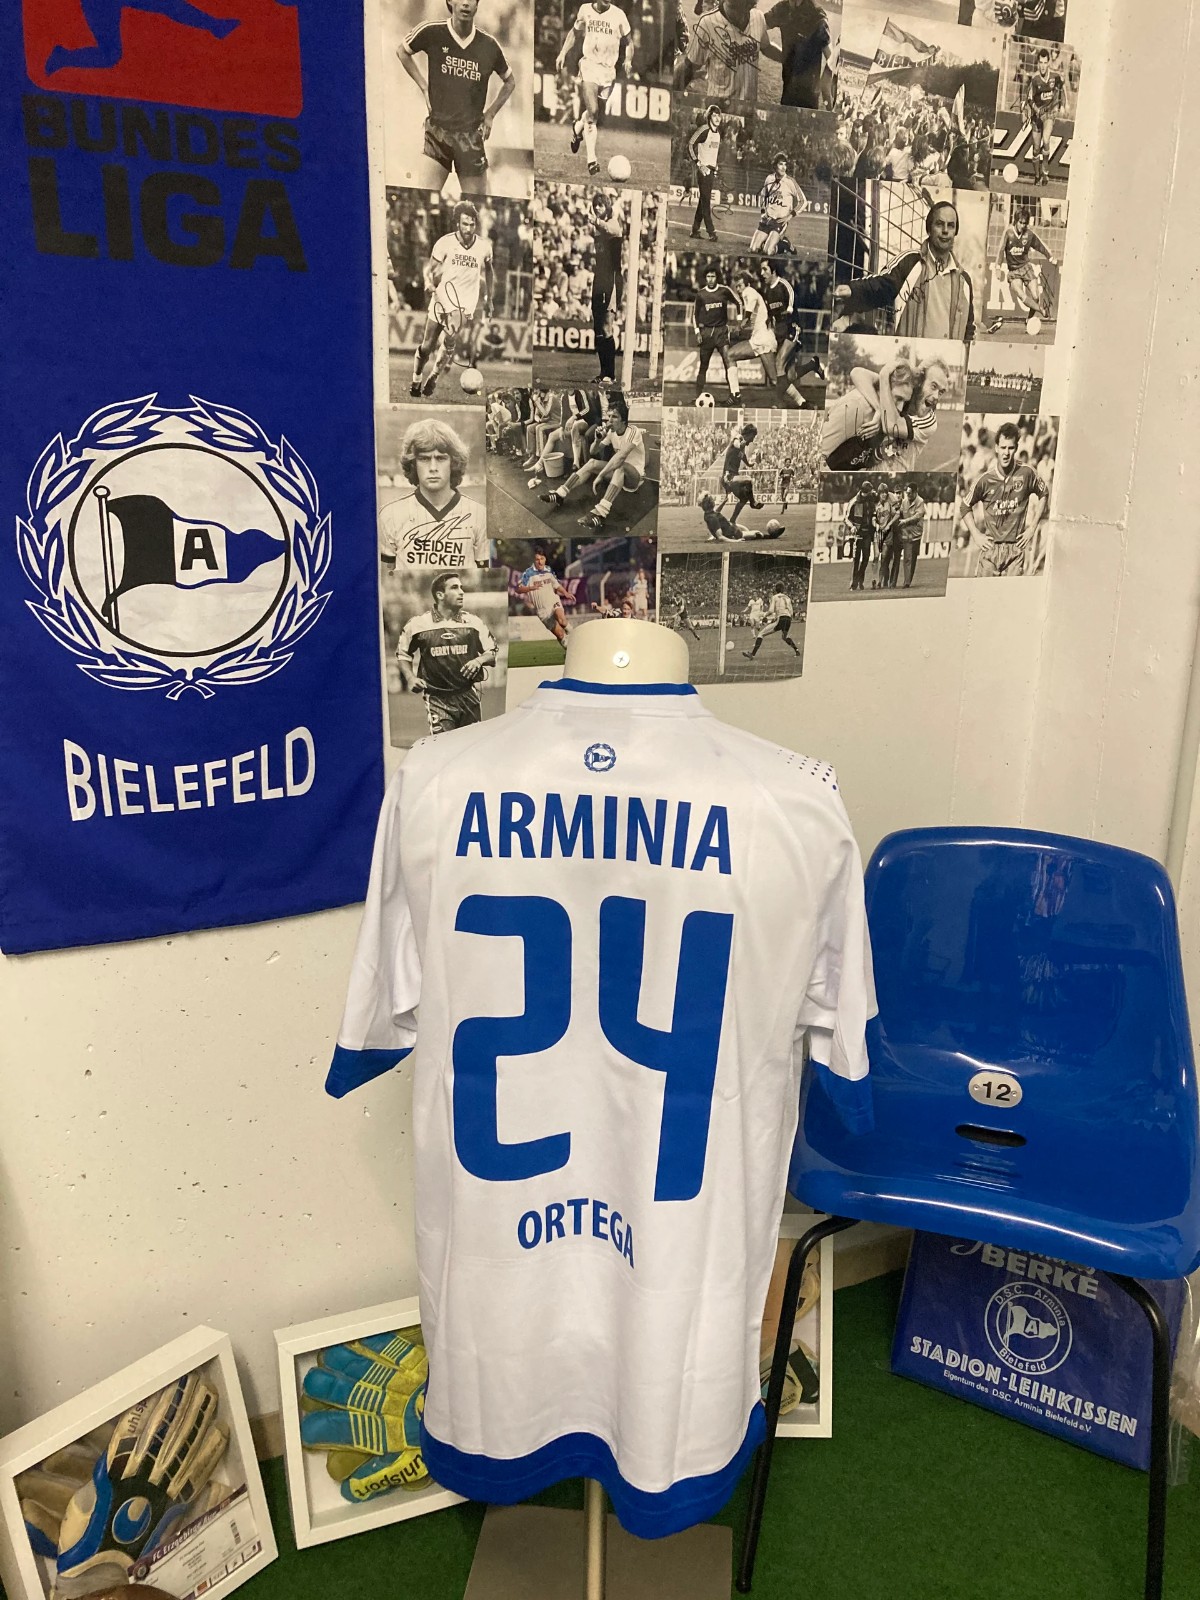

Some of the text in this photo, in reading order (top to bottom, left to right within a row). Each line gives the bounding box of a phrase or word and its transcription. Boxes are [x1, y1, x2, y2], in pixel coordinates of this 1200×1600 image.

[587, 26, 613, 35] STICKER
[588, 20, 611, 28] SEIDEN
[441, 63, 481, 81] STICKER
[445, 55, 479, 71] SEIDEN
[22, 94, 301, 173] BUNDES
[28, 156, 309, 273] LIGA
[451, 258, 479, 269] STICKER
[454, 253, 477, 263] SEIDEN
[180, 528, 219, 571] A
[407, 551, 466, 567] STICKER
[413, 538, 463, 555] SEIDEN
[63, 726, 316, 822] BIELEFELD
[455, 791, 733, 875] ARMINIA
[452, 894, 735, 1202] 24
[982, 1081, 1012, 1102] 12
[517, 1198, 635, 1269] ORTEGA
[981, 1243, 1099, 1300] BERKE
[994, 1284, 1067, 1328] D.S.C. Arminia
[999, 1346, 1047, 1373] Bielefeld
[910, 1335, 1138, 1438] STADION-LEIHKISSEN
[943, 1369, 975, 1388] Eigentum
[975, 1382, 989, 1394] des
[1014, 1398, 1043, 1415] Arminia
[1045, 1408, 1079, 1429] Bielefeld
[1079, 1423, 1093, 1434] e.V.
[127, 1400, 148, 1434] uhlsp
[354, 1453, 424, 1497] uhlsport
